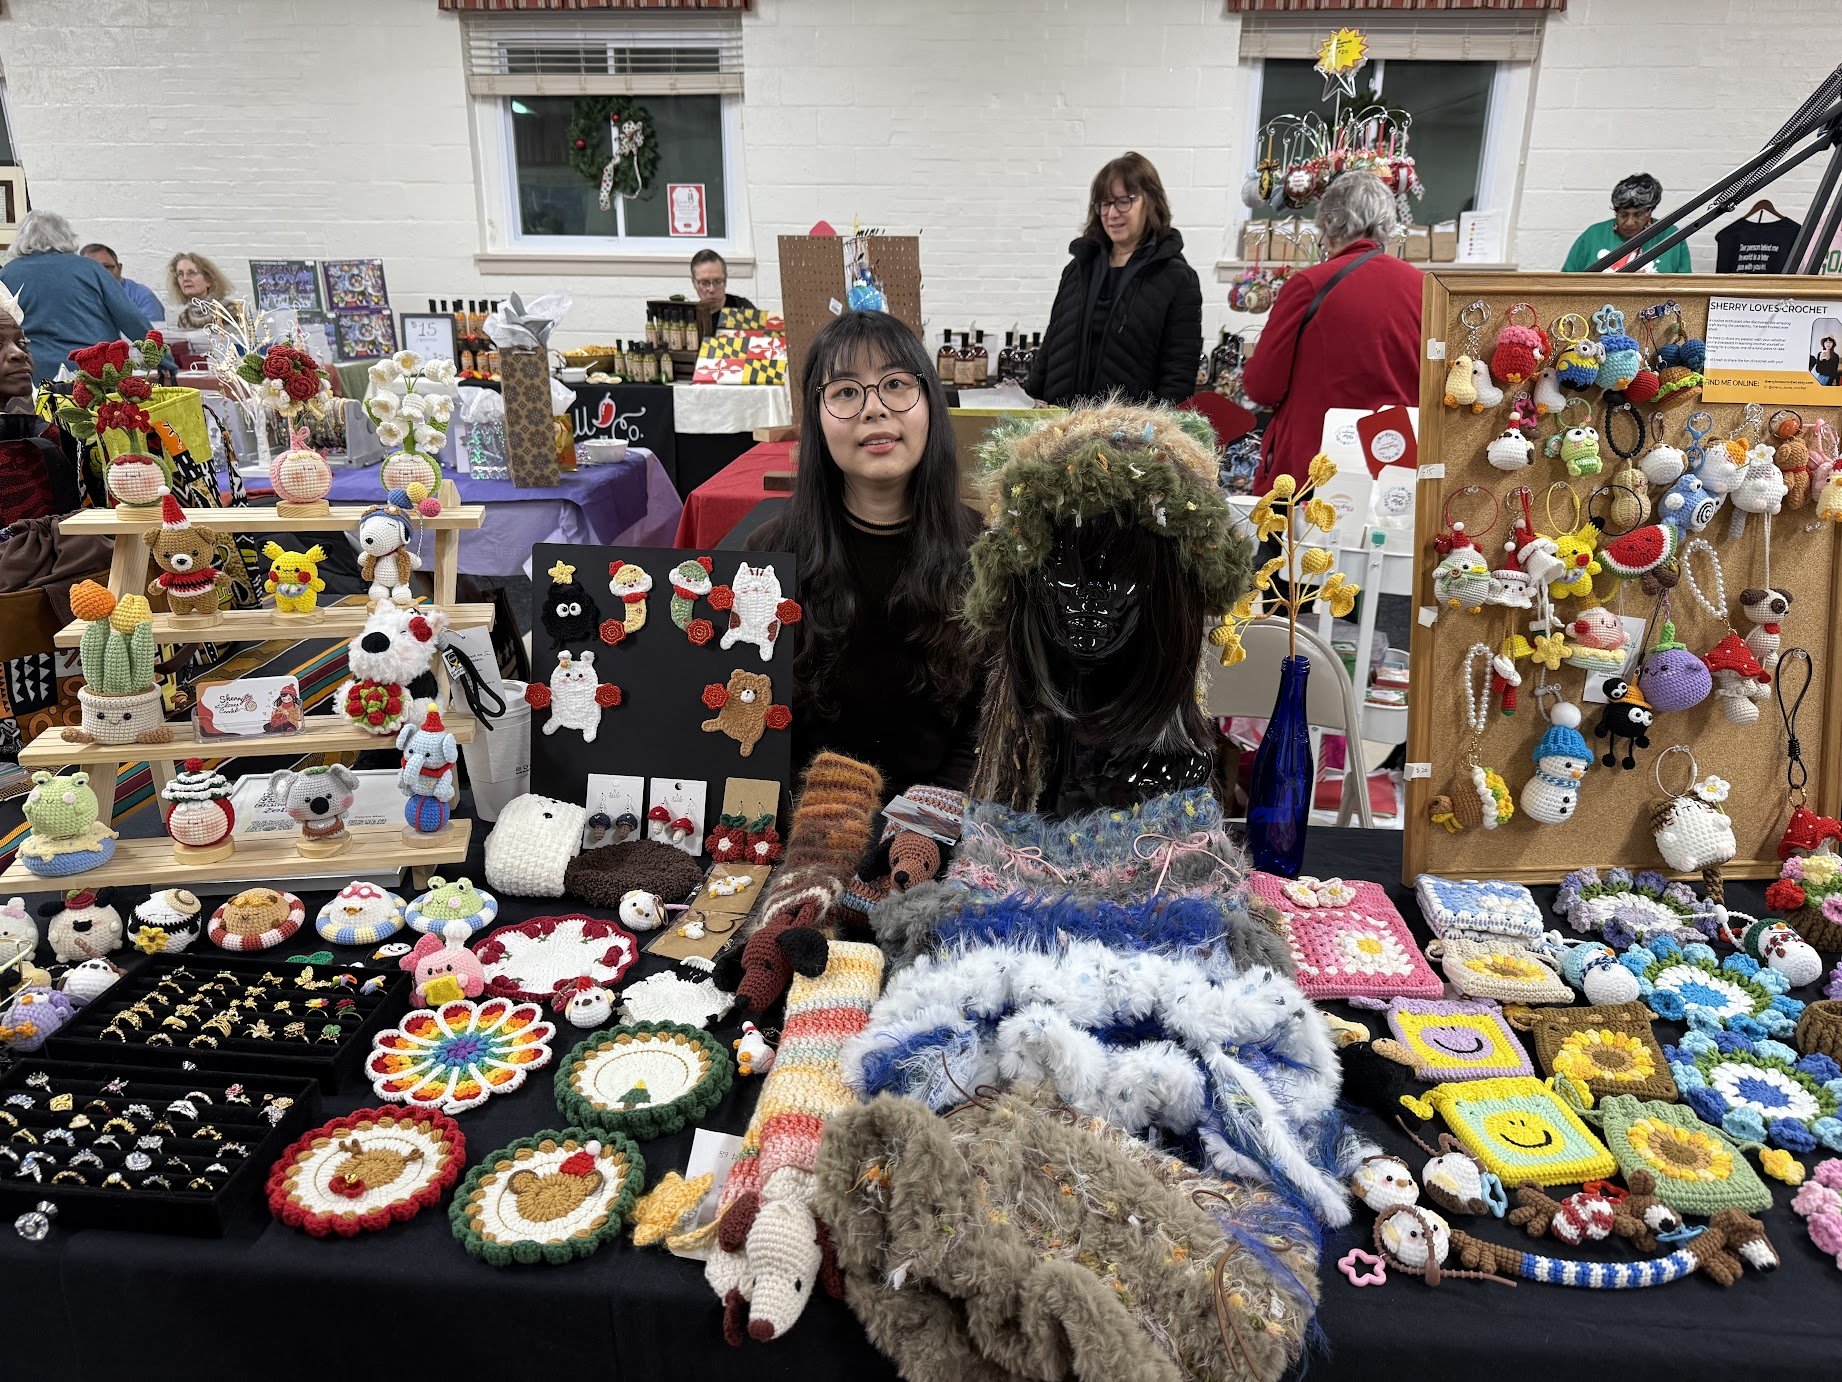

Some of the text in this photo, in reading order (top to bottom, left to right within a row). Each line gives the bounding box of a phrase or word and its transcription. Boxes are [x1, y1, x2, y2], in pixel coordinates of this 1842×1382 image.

[1710, 302, 1828, 314] SHERRY LOVES CROCHET
[611, 406, 646, 441] Co.
[220, 694, 243, 705] Sherry
